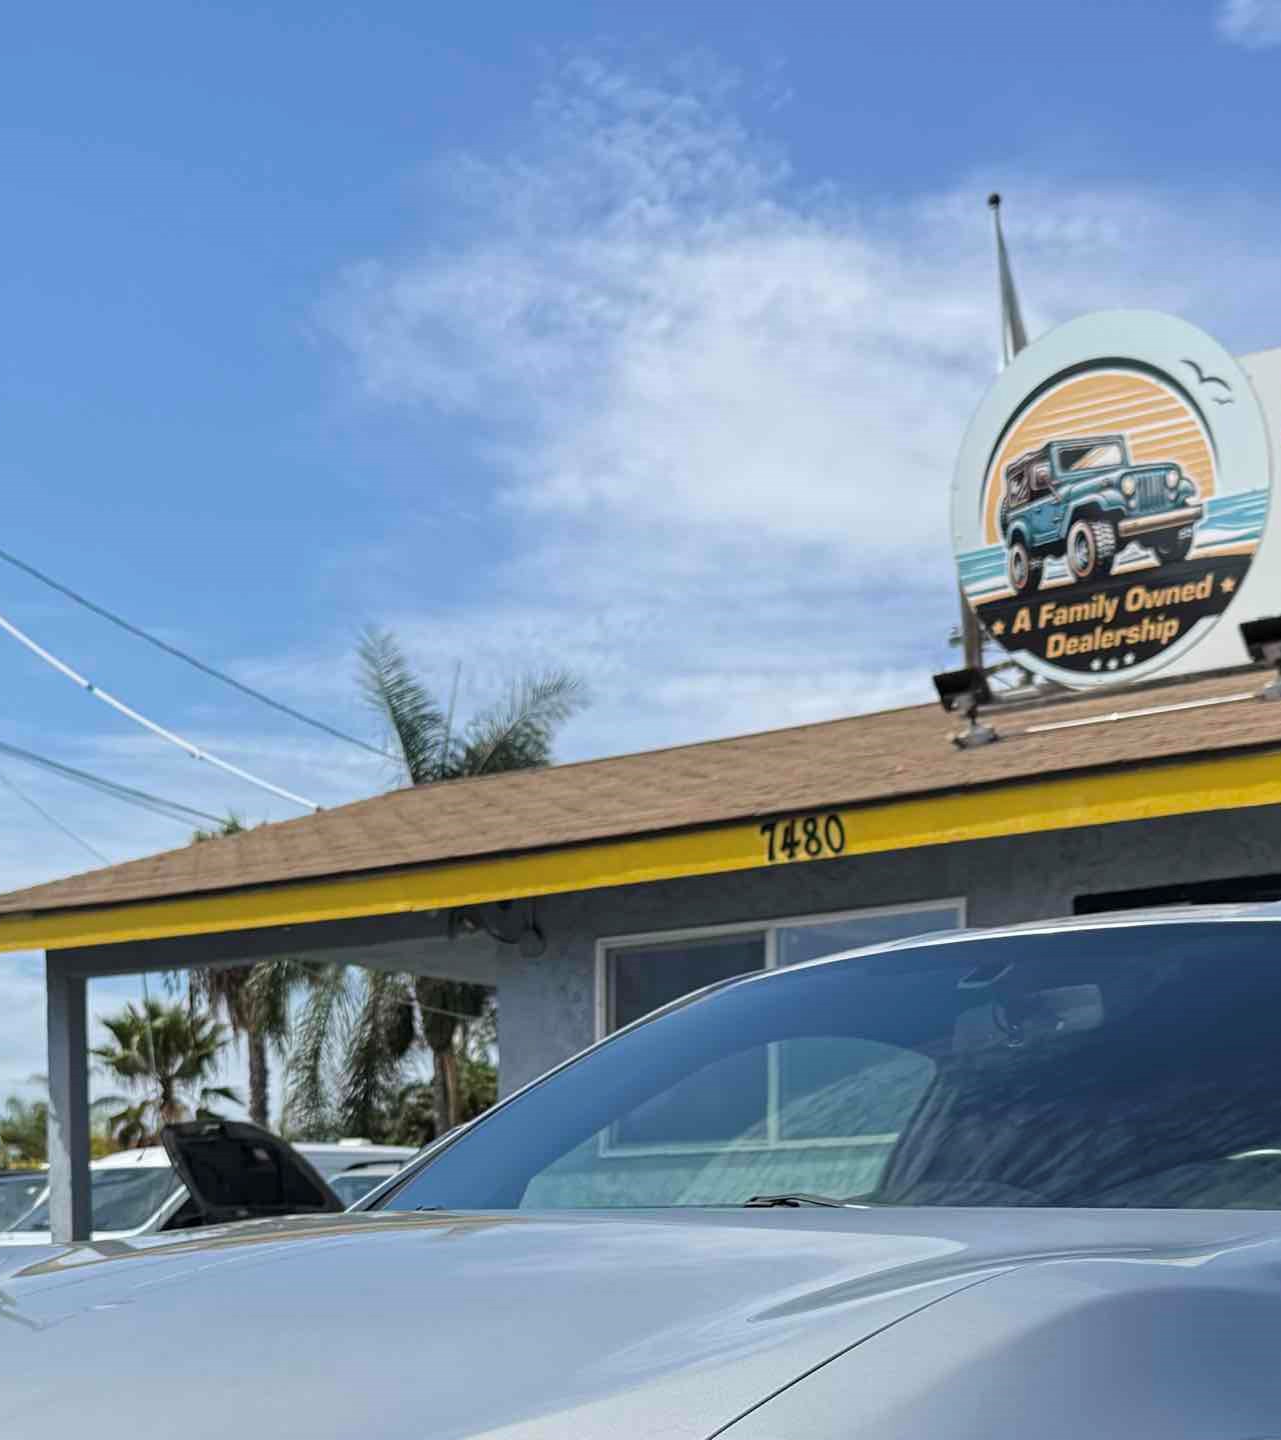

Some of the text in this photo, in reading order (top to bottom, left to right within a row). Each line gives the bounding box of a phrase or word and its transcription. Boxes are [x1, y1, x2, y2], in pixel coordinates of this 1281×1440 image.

[1010, 571, 1215, 635] A Family Owned
[1045, 612, 1181, 659] Dealership
[760, 813, 845, 861] 7480
